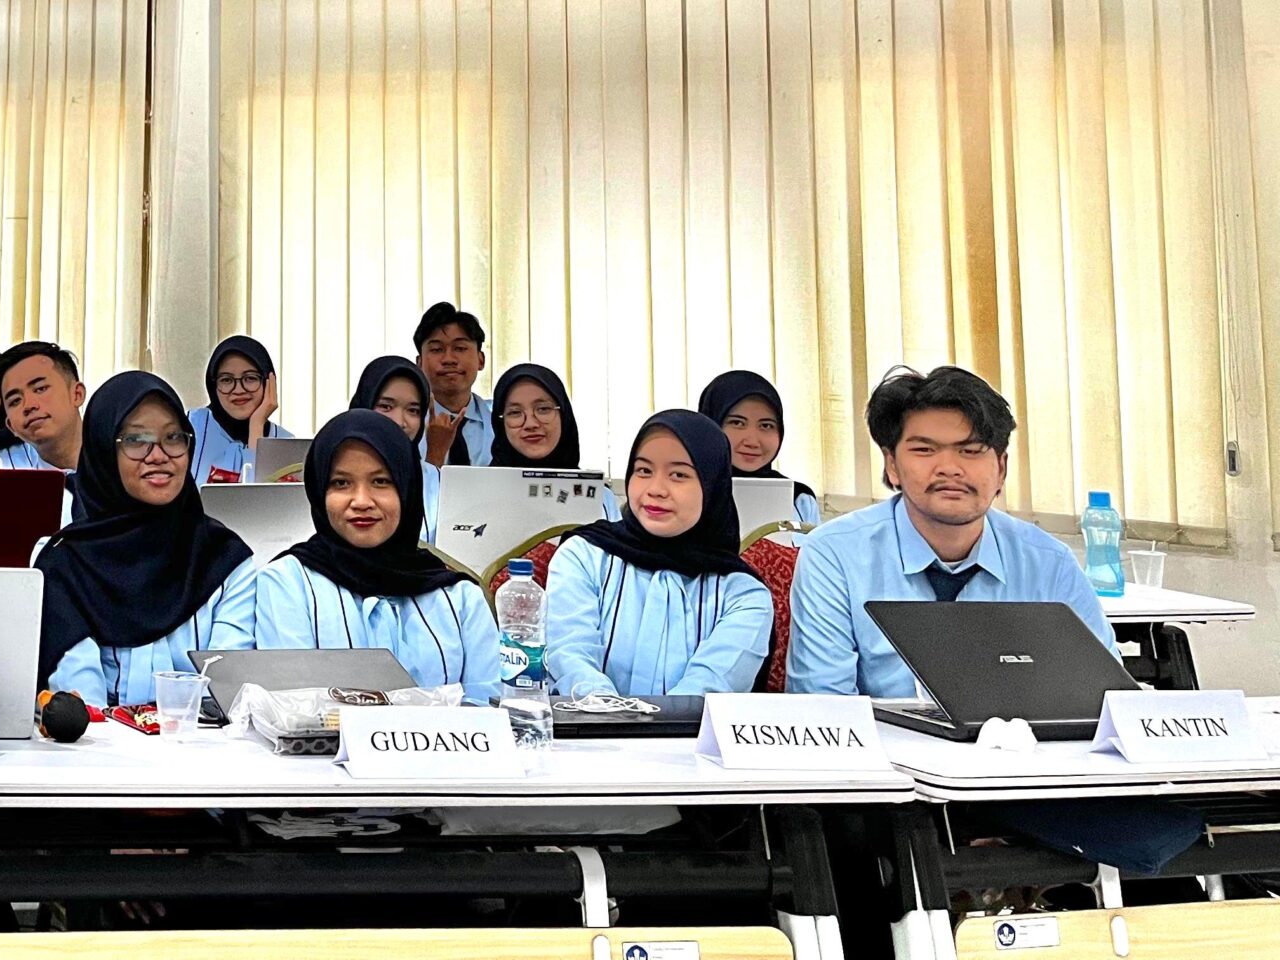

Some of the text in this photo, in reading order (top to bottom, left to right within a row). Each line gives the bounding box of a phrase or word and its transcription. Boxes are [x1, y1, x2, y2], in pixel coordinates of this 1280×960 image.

[999, 655, 1034, 663] ASUS
[731, 724, 865, 748] KISMAWA
[1140, 718, 1229, 737] KANTIN
[370, 731, 490, 753] GUDANG
